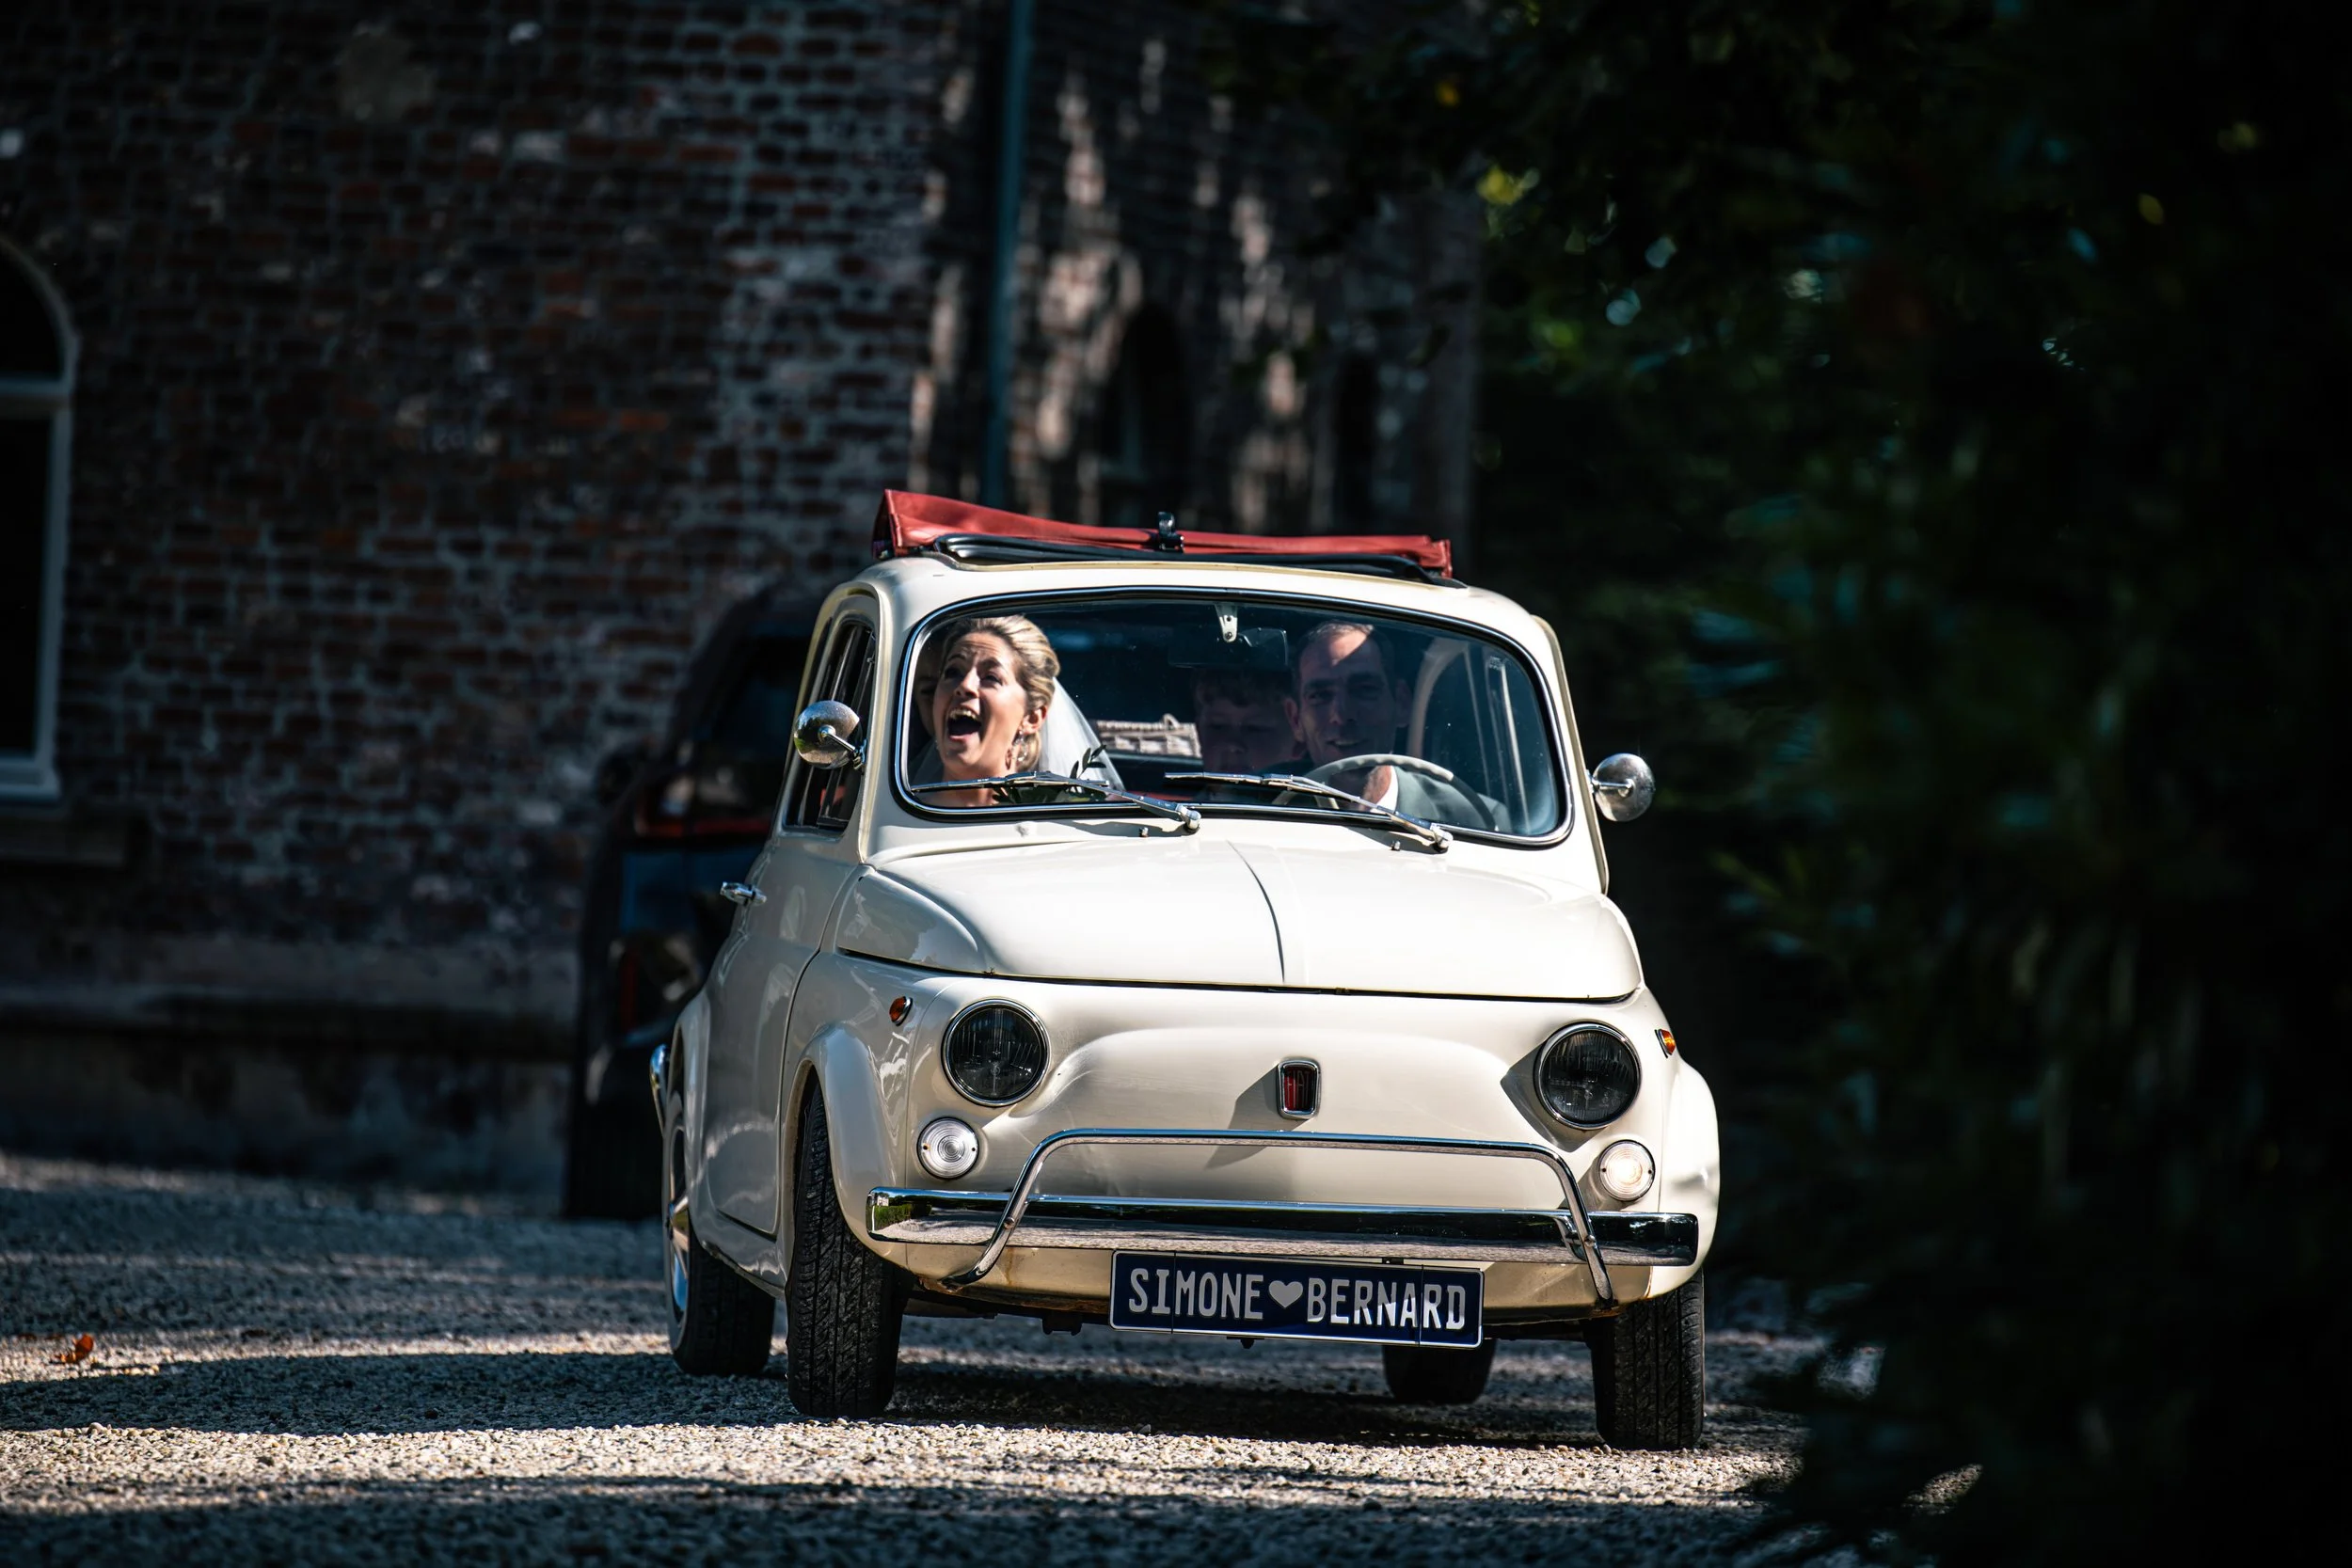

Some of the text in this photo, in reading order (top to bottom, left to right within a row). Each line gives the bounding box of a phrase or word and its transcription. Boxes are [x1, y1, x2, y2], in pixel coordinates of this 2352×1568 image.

[1286, 1069, 1311, 1108] FIAT
[1129, 1268, 1466, 1330] SIMONE BERNARD
